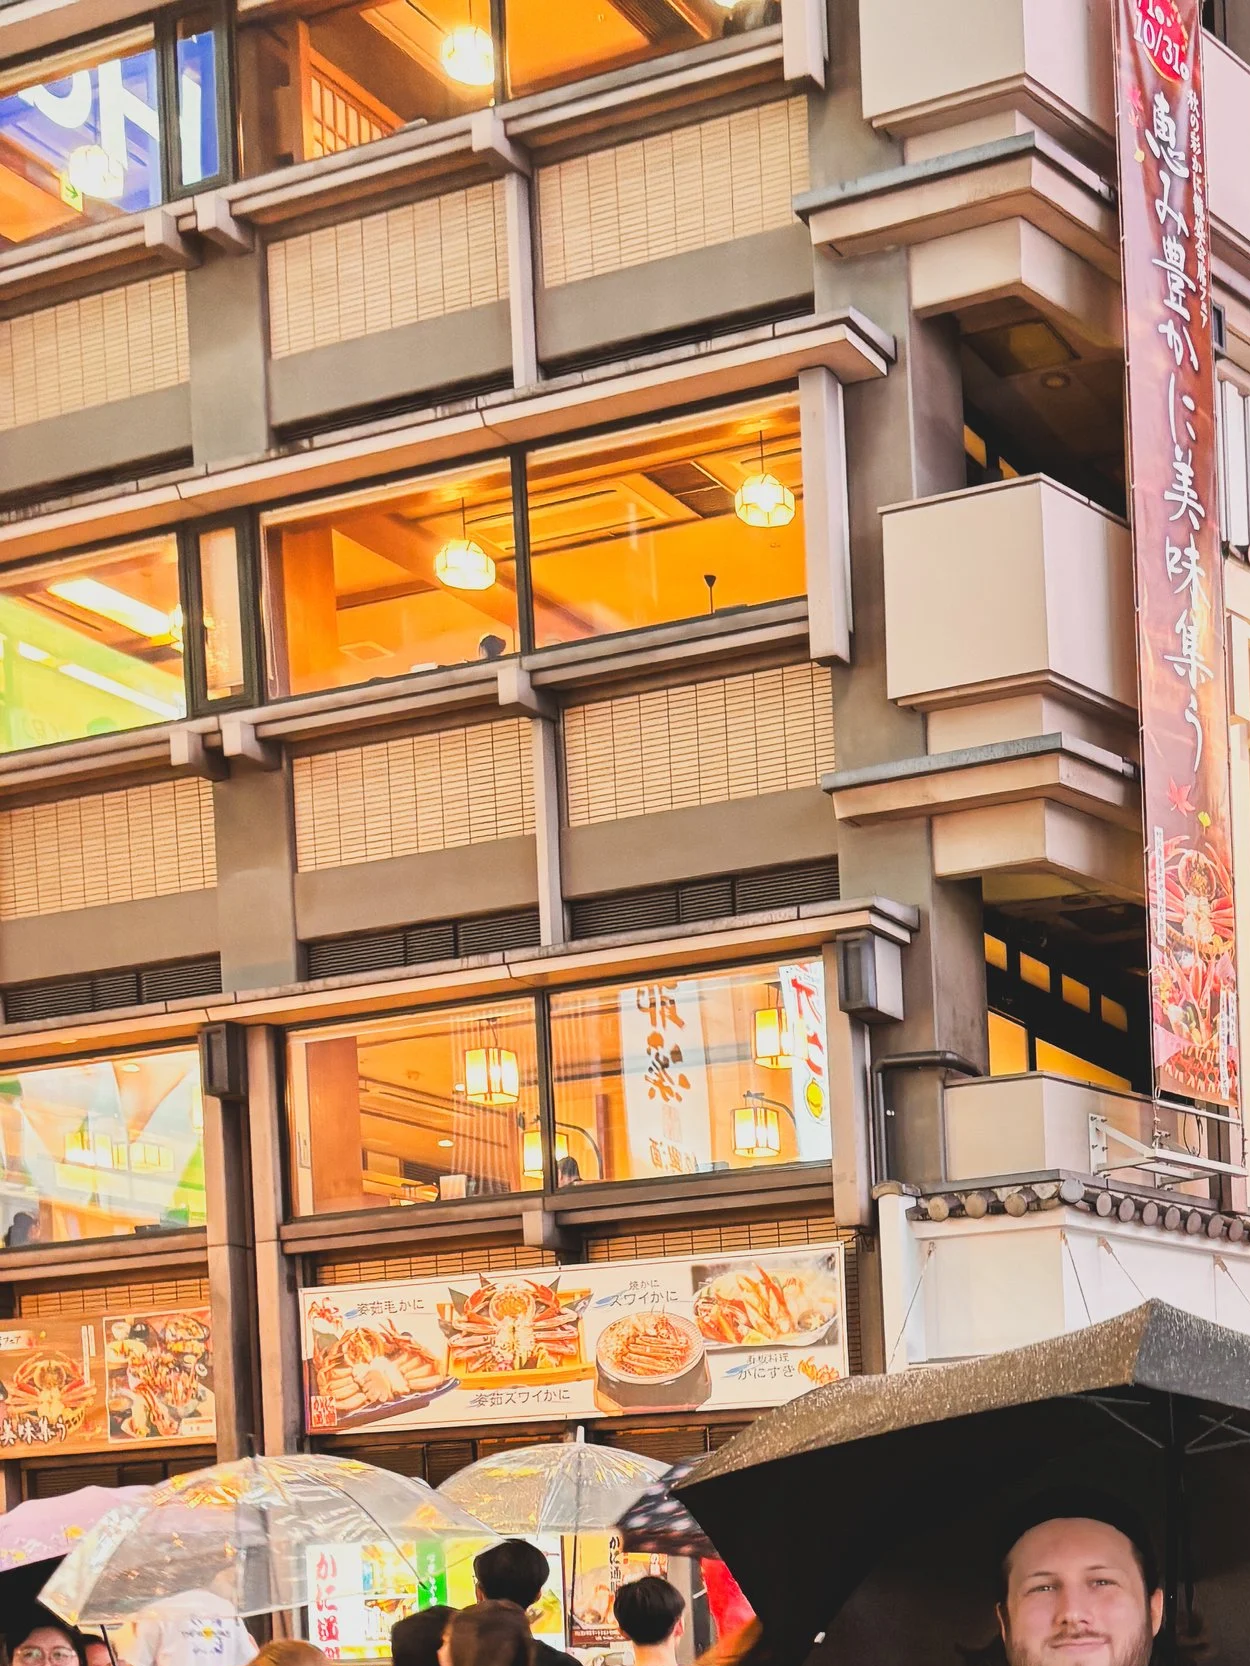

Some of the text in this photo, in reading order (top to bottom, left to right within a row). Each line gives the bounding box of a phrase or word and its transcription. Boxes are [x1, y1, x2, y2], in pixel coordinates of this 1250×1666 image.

[357, 1299, 425, 1316] 姿茹毛かに
